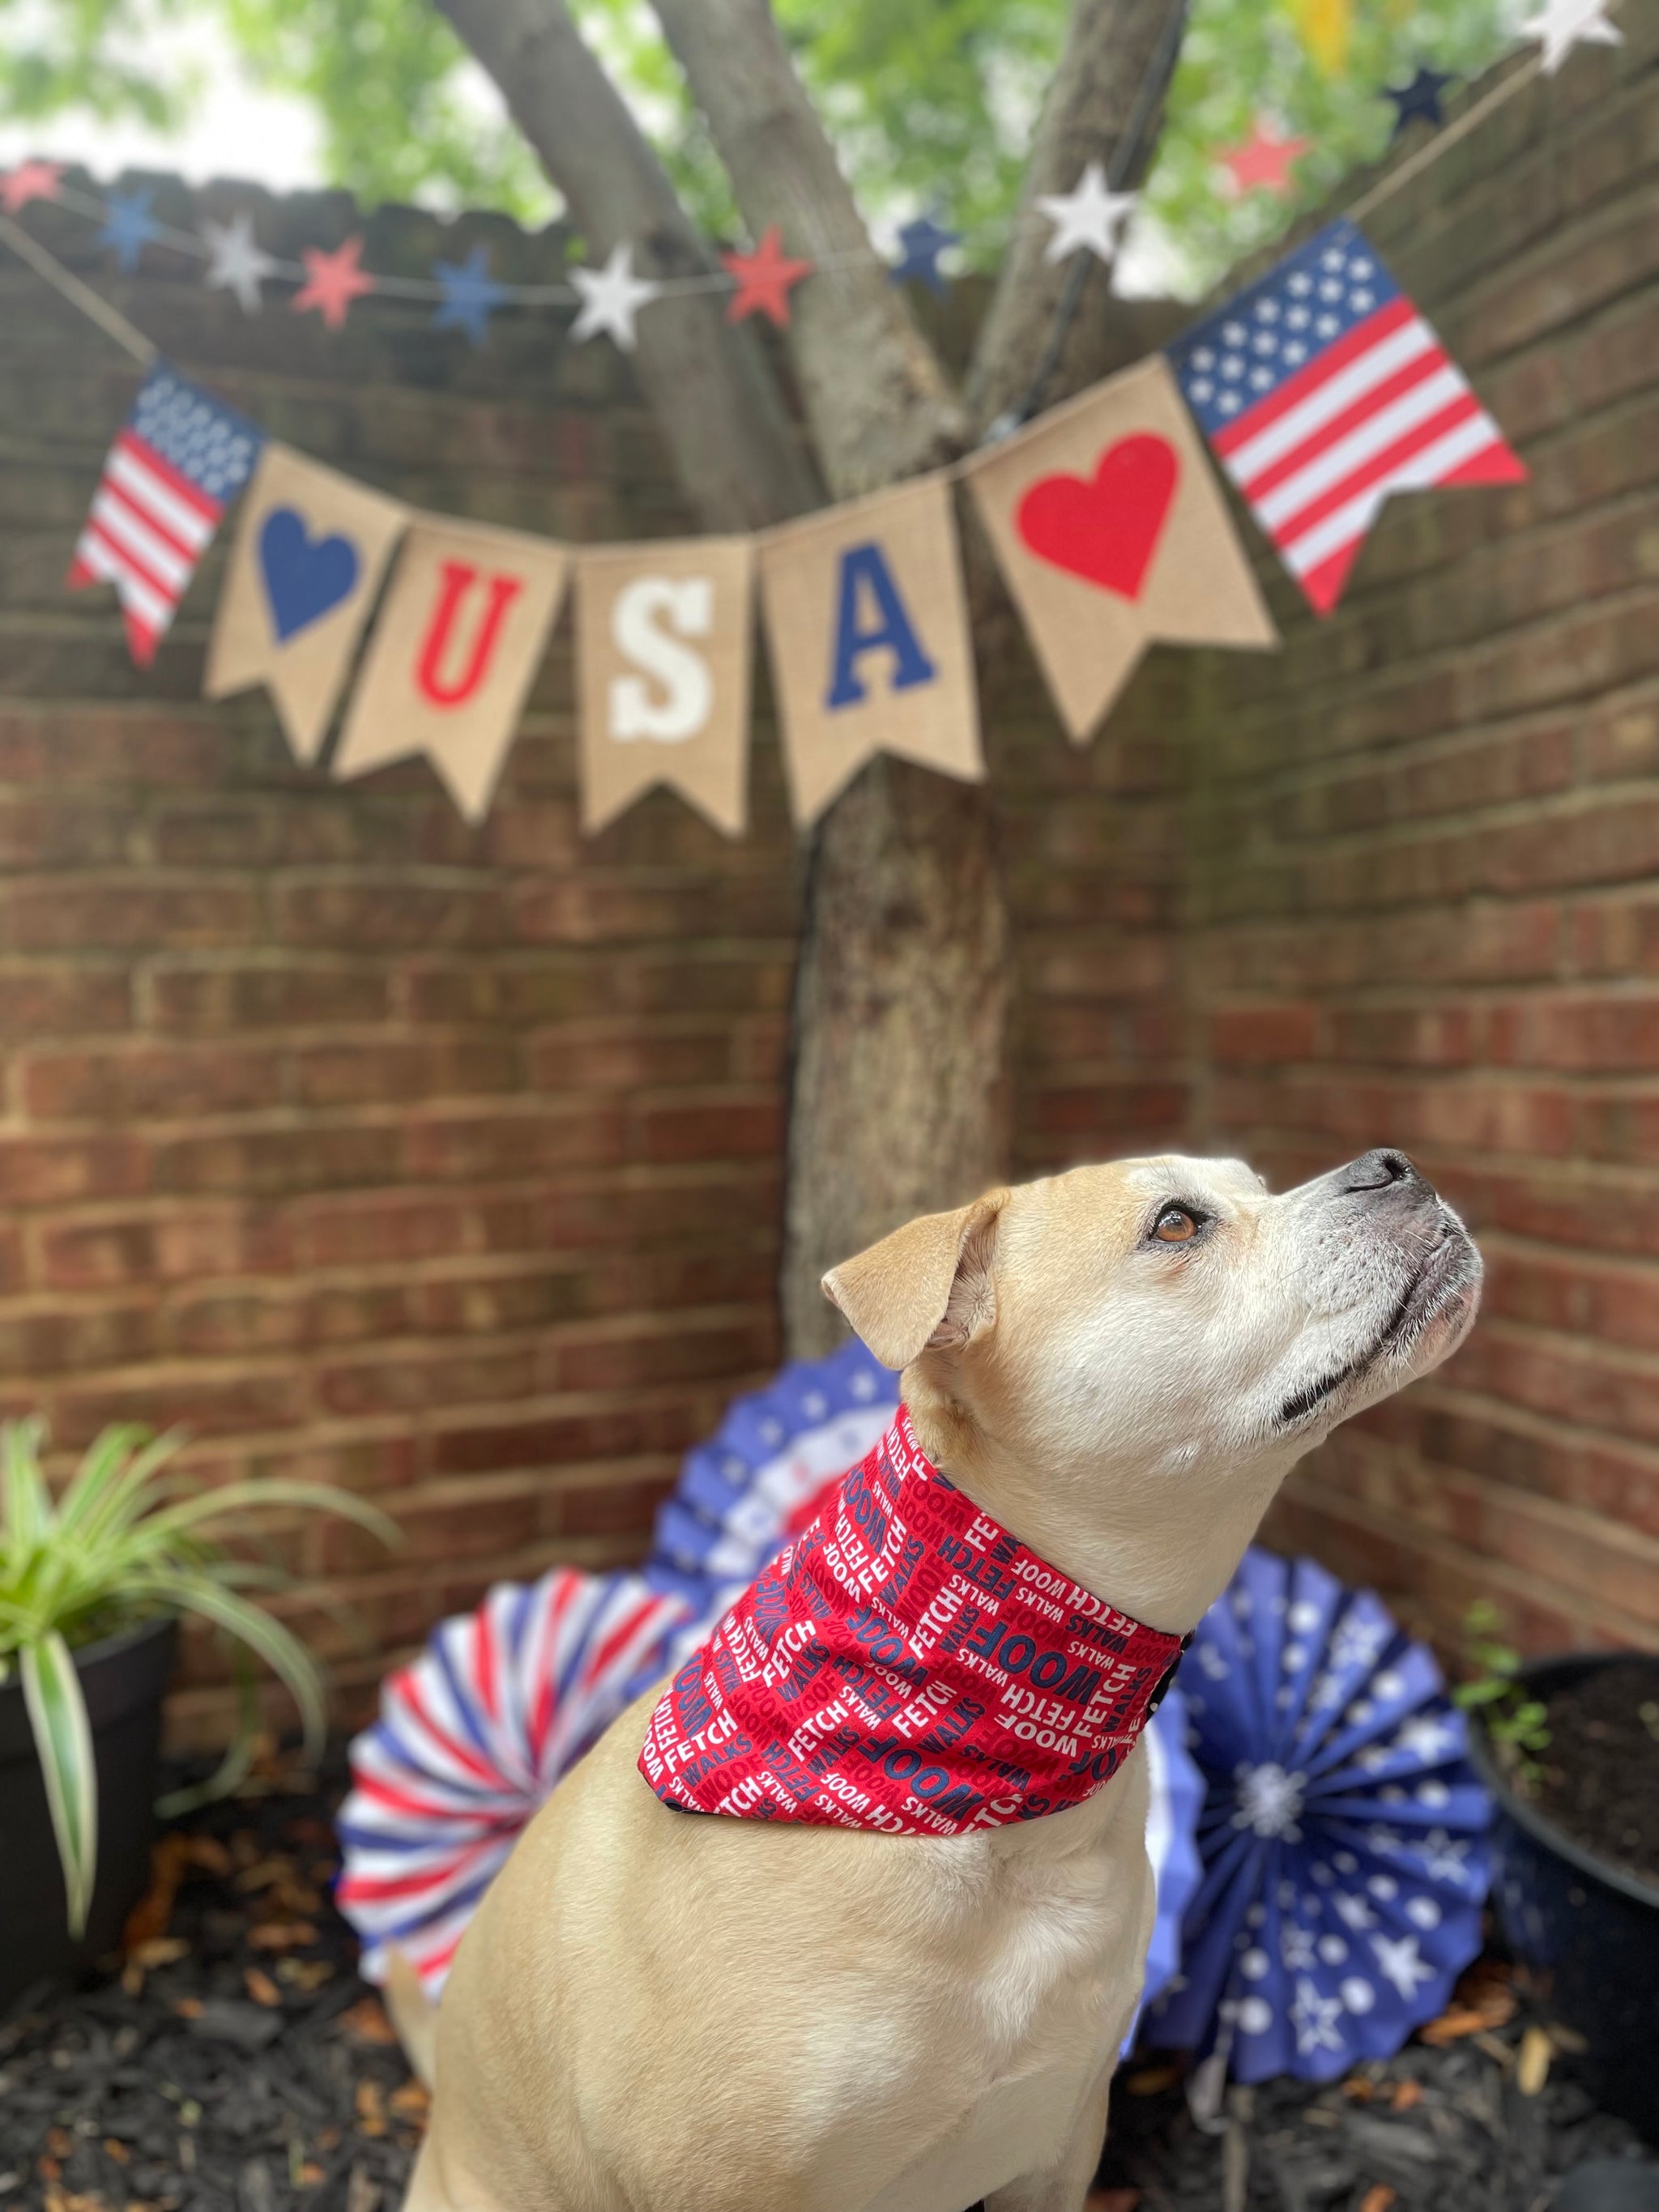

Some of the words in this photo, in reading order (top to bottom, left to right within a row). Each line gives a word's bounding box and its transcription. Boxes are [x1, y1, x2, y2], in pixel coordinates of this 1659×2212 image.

[415, 559, 523, 708] U
[610, 576, 710, 742] S
[825, 540, 937, 710] A
[886, 1426, 911, 1481] FETCH
[872, 1481, 893, 1519] WALKS
[834, 1513, 868, 1571] FETCH
[857, 1515, 907, 1595] FETCH
[964, 1511, 999, 1553] FE
[823, 1542, 860, 1603] WOOF
[880, 1535, 925, 1608] WALKS
[898, 1554, 949, 1626] WOOF
[937, 1536, 1017, 1600] FETCH
[1011, 1558, 1067, 1601] WOOF
[871, 1597, 909, 1639] WALKS
[949, 1574, 1000, 1617] WALKS
[1015, 1588, 1064, 1623] WALKS
[1066, 1585, 1139, 1638] FETCH
[744, 1617, 769, 1662] WALKS
[847, 1605, 928, 1686] WOOF
[908, 1587, 962, 1660] FETCH
[939, 1605, 980, 1654] WALKS
[1000, 1604, 1070, 1648] WOOF
[1066, 1614, 1129, 1654] WALKS
[727, 1625, 761, 1682] FETCH
[761, 1621, 817, 1688] FETCH
[777, 1637, 830, 1703] WALKS
[864, 1662, 912, 1699] WOOF
[956, 1647, 1009, 1688] WALKS
[965, 1621, 1102, 1706] WOOF
[1068, 1641, 1115, 1670] WALKS
[704, 1672, 724, 1711] WALKS
[782, 1672, 839, 1721] WOOF
[831, 1655, 901, 1720] FETCH
[839, 1686, 881, 1731] WALKS
[891, 1680, 957, 1739] FETCH
[1000, 1683, 1077, 1731] FETCH
[1073, 1664, 1136, 1738] FETCH
[1102, 1667, 1152, 1733] WALKS
[655, 1697, 679, 1751] FETCH
[664, 1709, 738, 1774] FETCH
[787, 1700, 849, 1762] FETCH
[806, 1725, 859, 1775] WALKS
[916, 1697, 985, 1755] WALKS
[994, 1714, 1078, 1758] WOOF
[680, 1733, 753, 1788] WALKS
[695, 1754, 762, 1808] WOOF
[761, 1739, 821, 1802] FETCH
[842, 1757, 901, 1802] WOOF
[857, 1735, 984, 1822] WOOF
[756, 1771, 797, 1813] WALKS
[820, 1773, 870, 1814] WOOF
[901, 1796, 957, 1835] WALKS
[865, 1805, 916, 1834] CH
